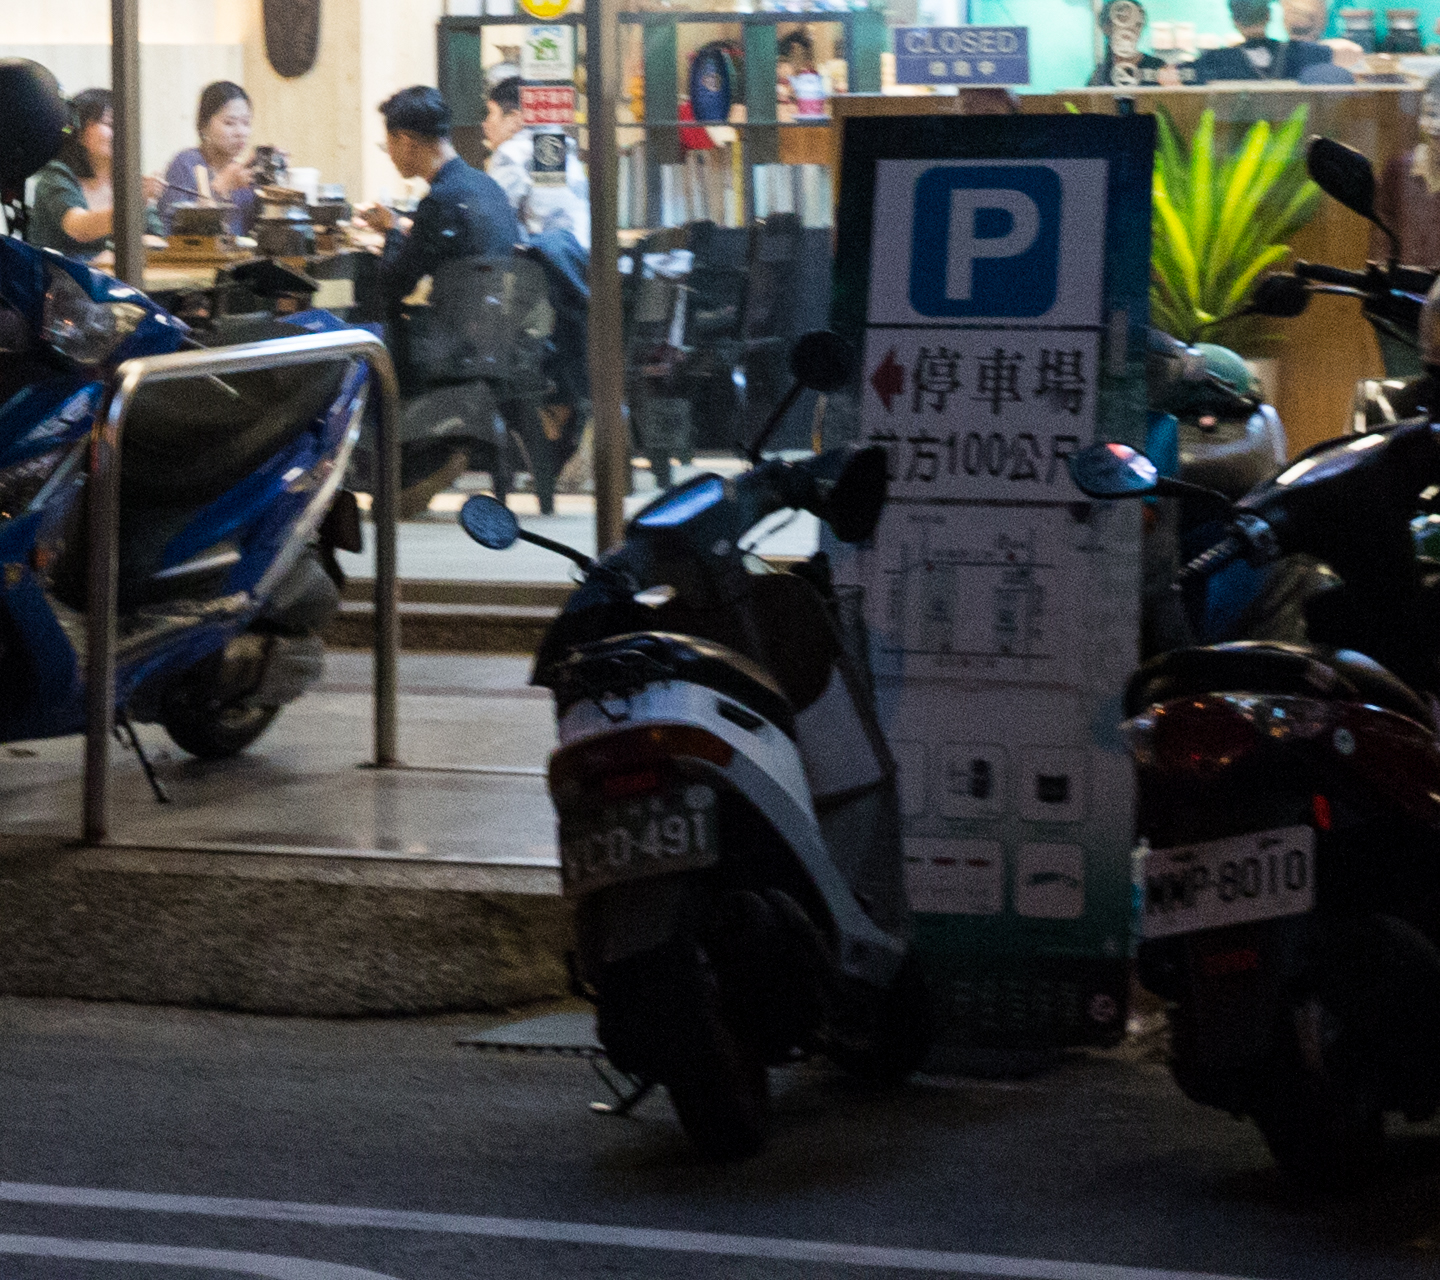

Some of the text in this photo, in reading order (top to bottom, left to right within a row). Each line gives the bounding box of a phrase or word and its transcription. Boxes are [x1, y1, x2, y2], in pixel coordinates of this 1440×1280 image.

[904, 29, 1019, 54] CLOSED
[946, 189, 1040, 299] P
[912, 345, 1086, 416] 停車場
